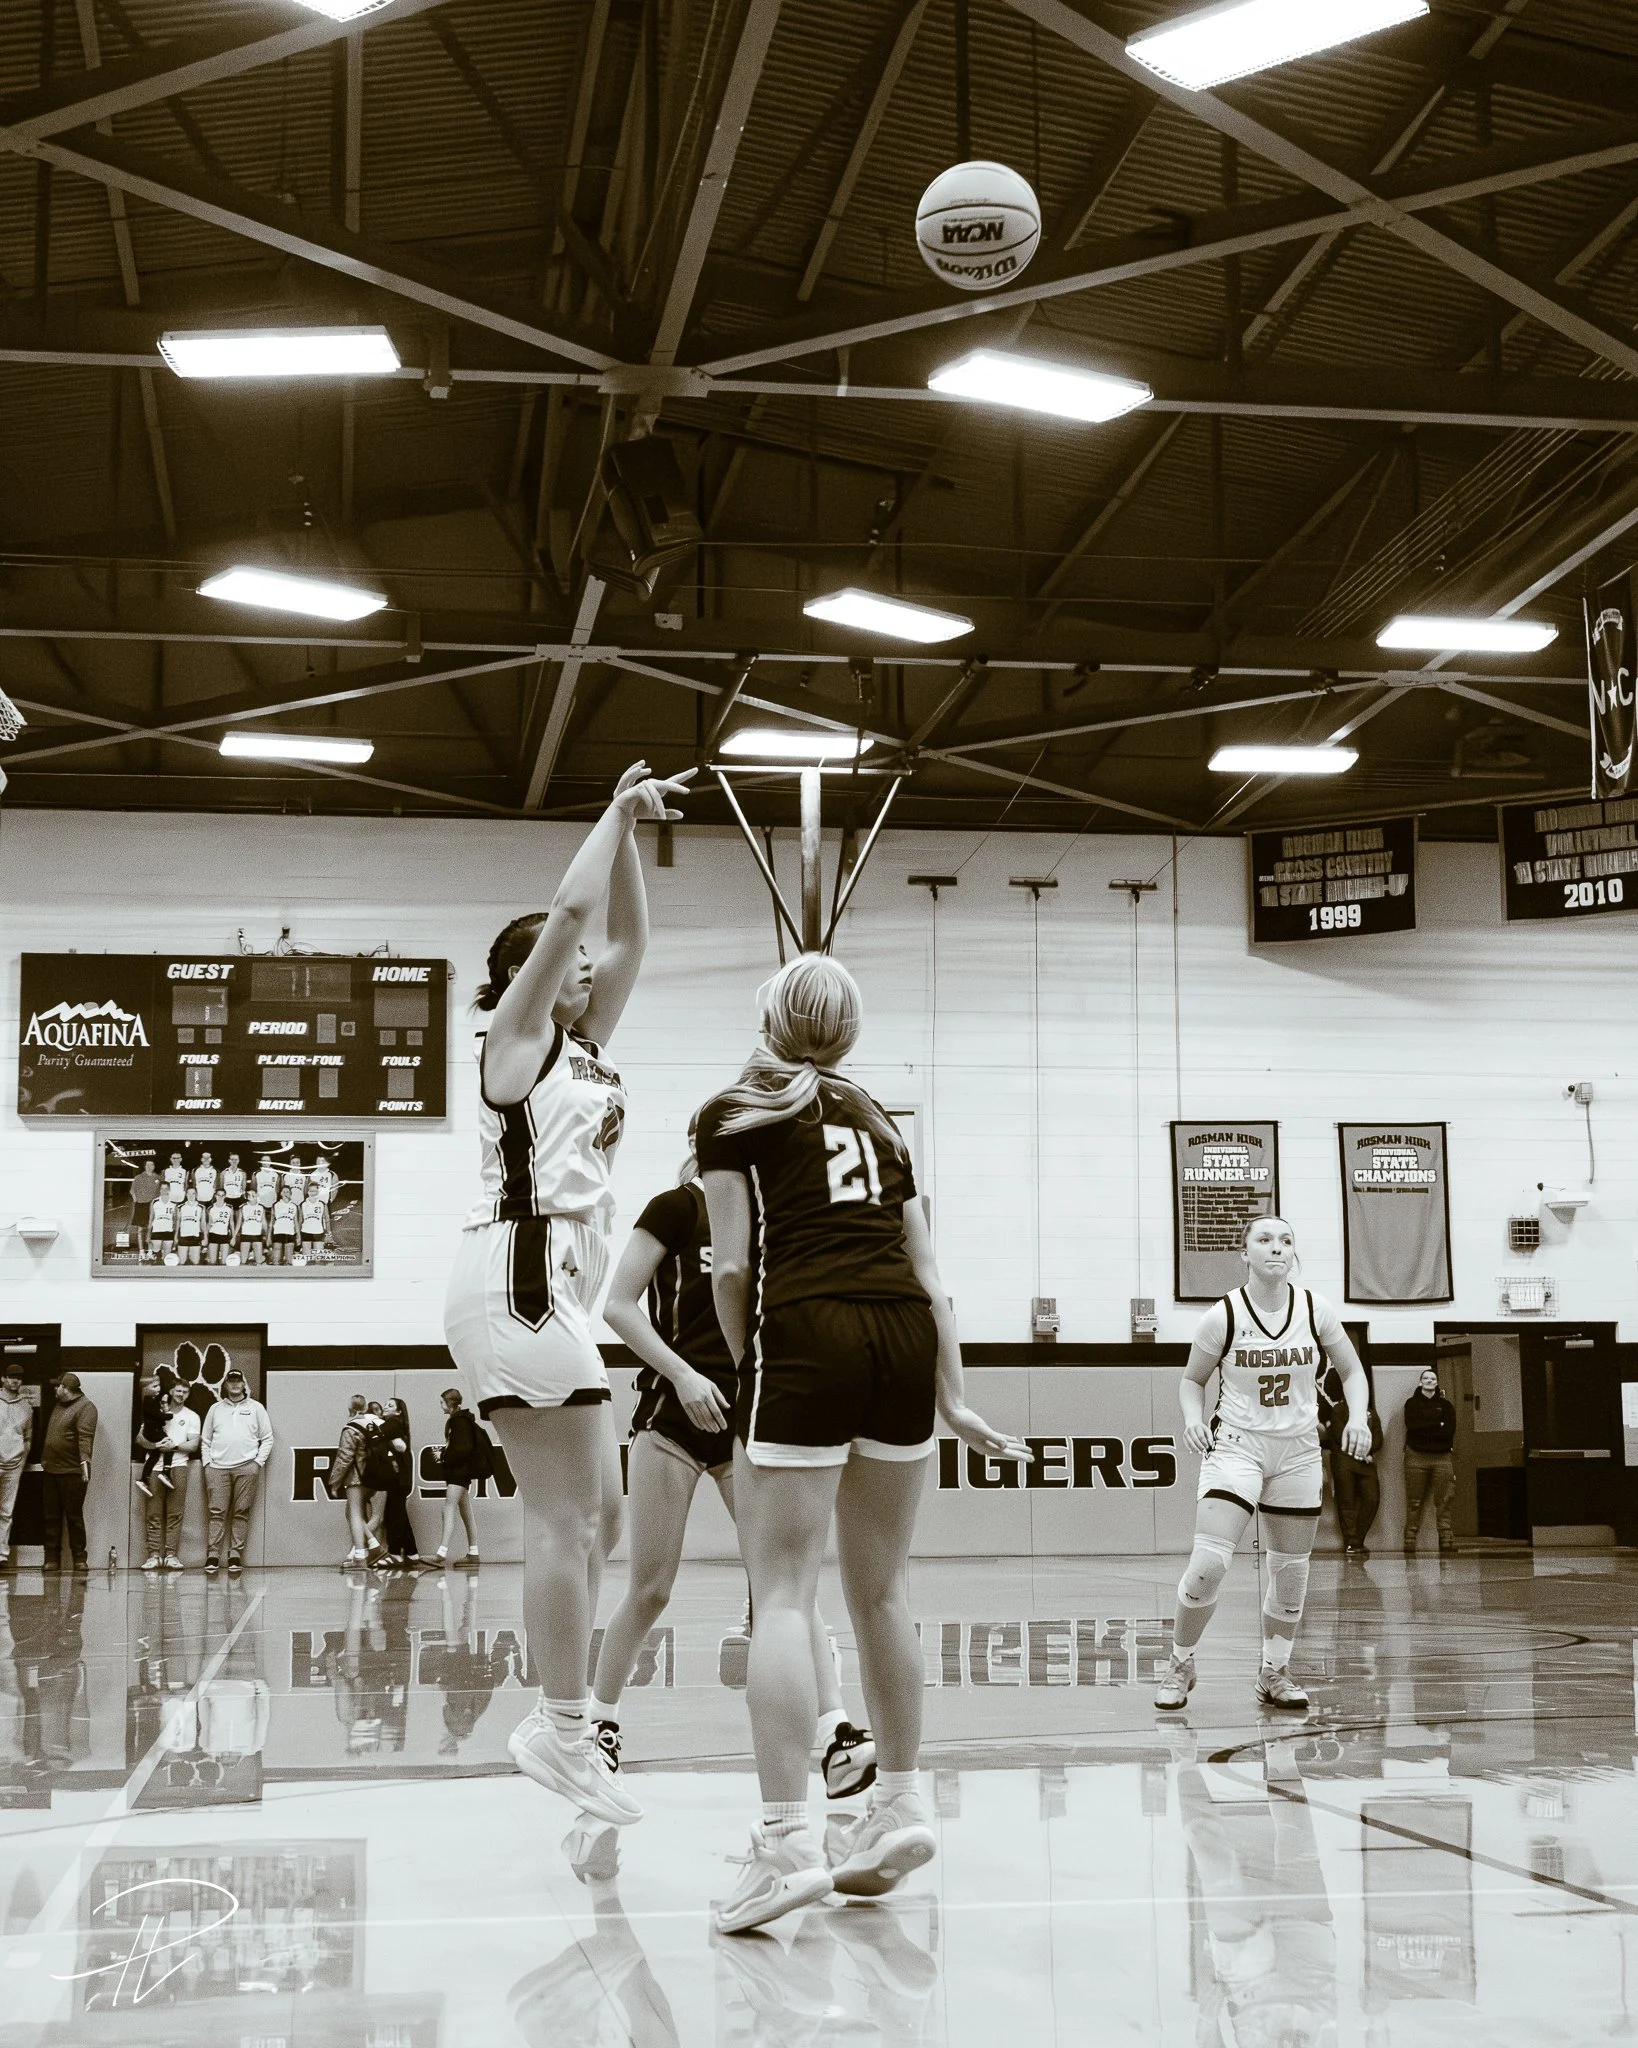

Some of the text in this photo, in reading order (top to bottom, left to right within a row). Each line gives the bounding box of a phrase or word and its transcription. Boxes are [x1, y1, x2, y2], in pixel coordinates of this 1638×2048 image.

[942, 221, 1005, 244] NCAA
[1564, 878, 1624, 908] 2010
[1309, 904, 1362, 931] 1999
[167, 963, 234, 979] GUEST
[372, 966, 431, 982] HOME
[21, 1012, 151, 1052] AQUAFINA
[248, 1021, 308, 1035] PERIOD
[37, 1053, 134, 1069] Purity Guaranteed
[179, 1054, 219, 1065] FOULS
[258, 1054, 344, 1065] PLAYER-FOUL
[381, 1056, 421, 1066] FOULS
[176, 1098, 222, 1110] POINTS
[258, 1100, 304, 1110] MATCH
[378, 1101, 424, 1111] POINTS
[1188, 1133, 1263, 1148] ROSMAN HIGH
[1357, 1135, 1432, 1150] ROSMAN HIGH
[823, 1124, 882, 1206] 21
[1203, 1154, 1250, 1168] STATE
[1372, 1156, 1418, 1169] STATE
[1183, 1167, 1269, 1181] RUNNER-UP
[1353, 1169, 1436, 1183] CHAMPIONS
[1234, 1346, 1313, 1368] ROSMAN
[1257, 1373, 1291, 1407] 22
